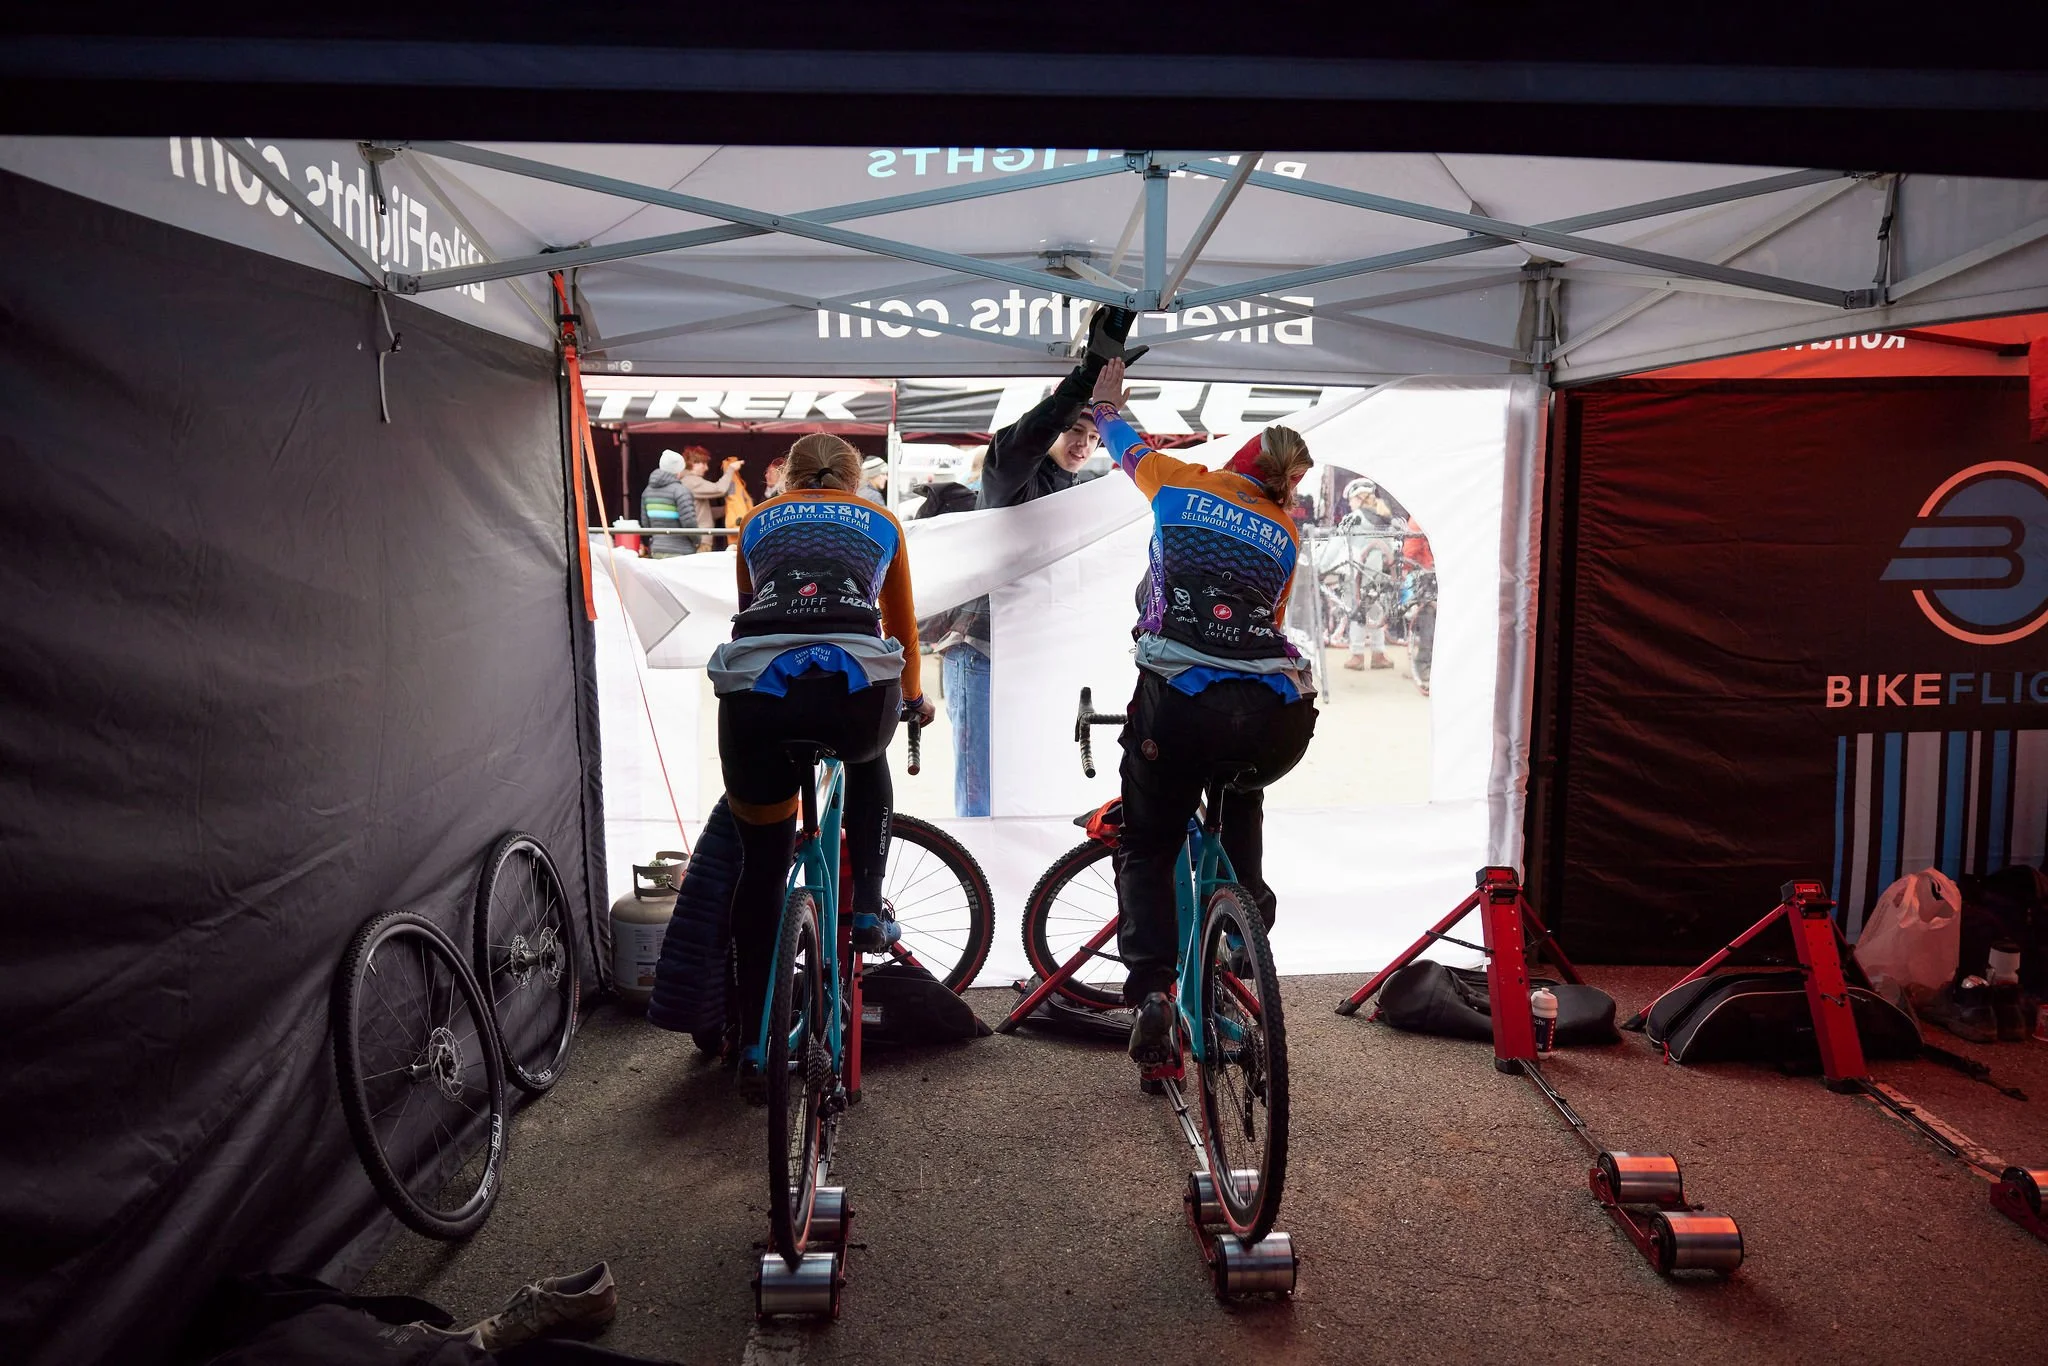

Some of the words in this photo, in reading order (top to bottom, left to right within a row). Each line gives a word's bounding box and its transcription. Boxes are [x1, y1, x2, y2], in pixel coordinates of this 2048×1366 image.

[584, 388, 865, 420] TREK
[757, 504, 816, 525] TEAM
[823, 504, 871, 524] S&M
[759, 513, 803, 534] SELLWOOD
[839, 515, 870, 532] REPAIR
[1185, 493, 1243, 524] TEAM
[1246, 516, 1289, 550] S&M
[1181, 511, 1228, 528] SELLWOOD
[1230, 525, 1256, 540] CYCLE
[1258, 536, 1282, 559] REPAIR
[786, 606, 827, 615] COFFEE
[791, 597, 828, 607] PUFF
[839, 595, 873, 611] LAZER
[1208, 622, 1241, 634] PUFF
